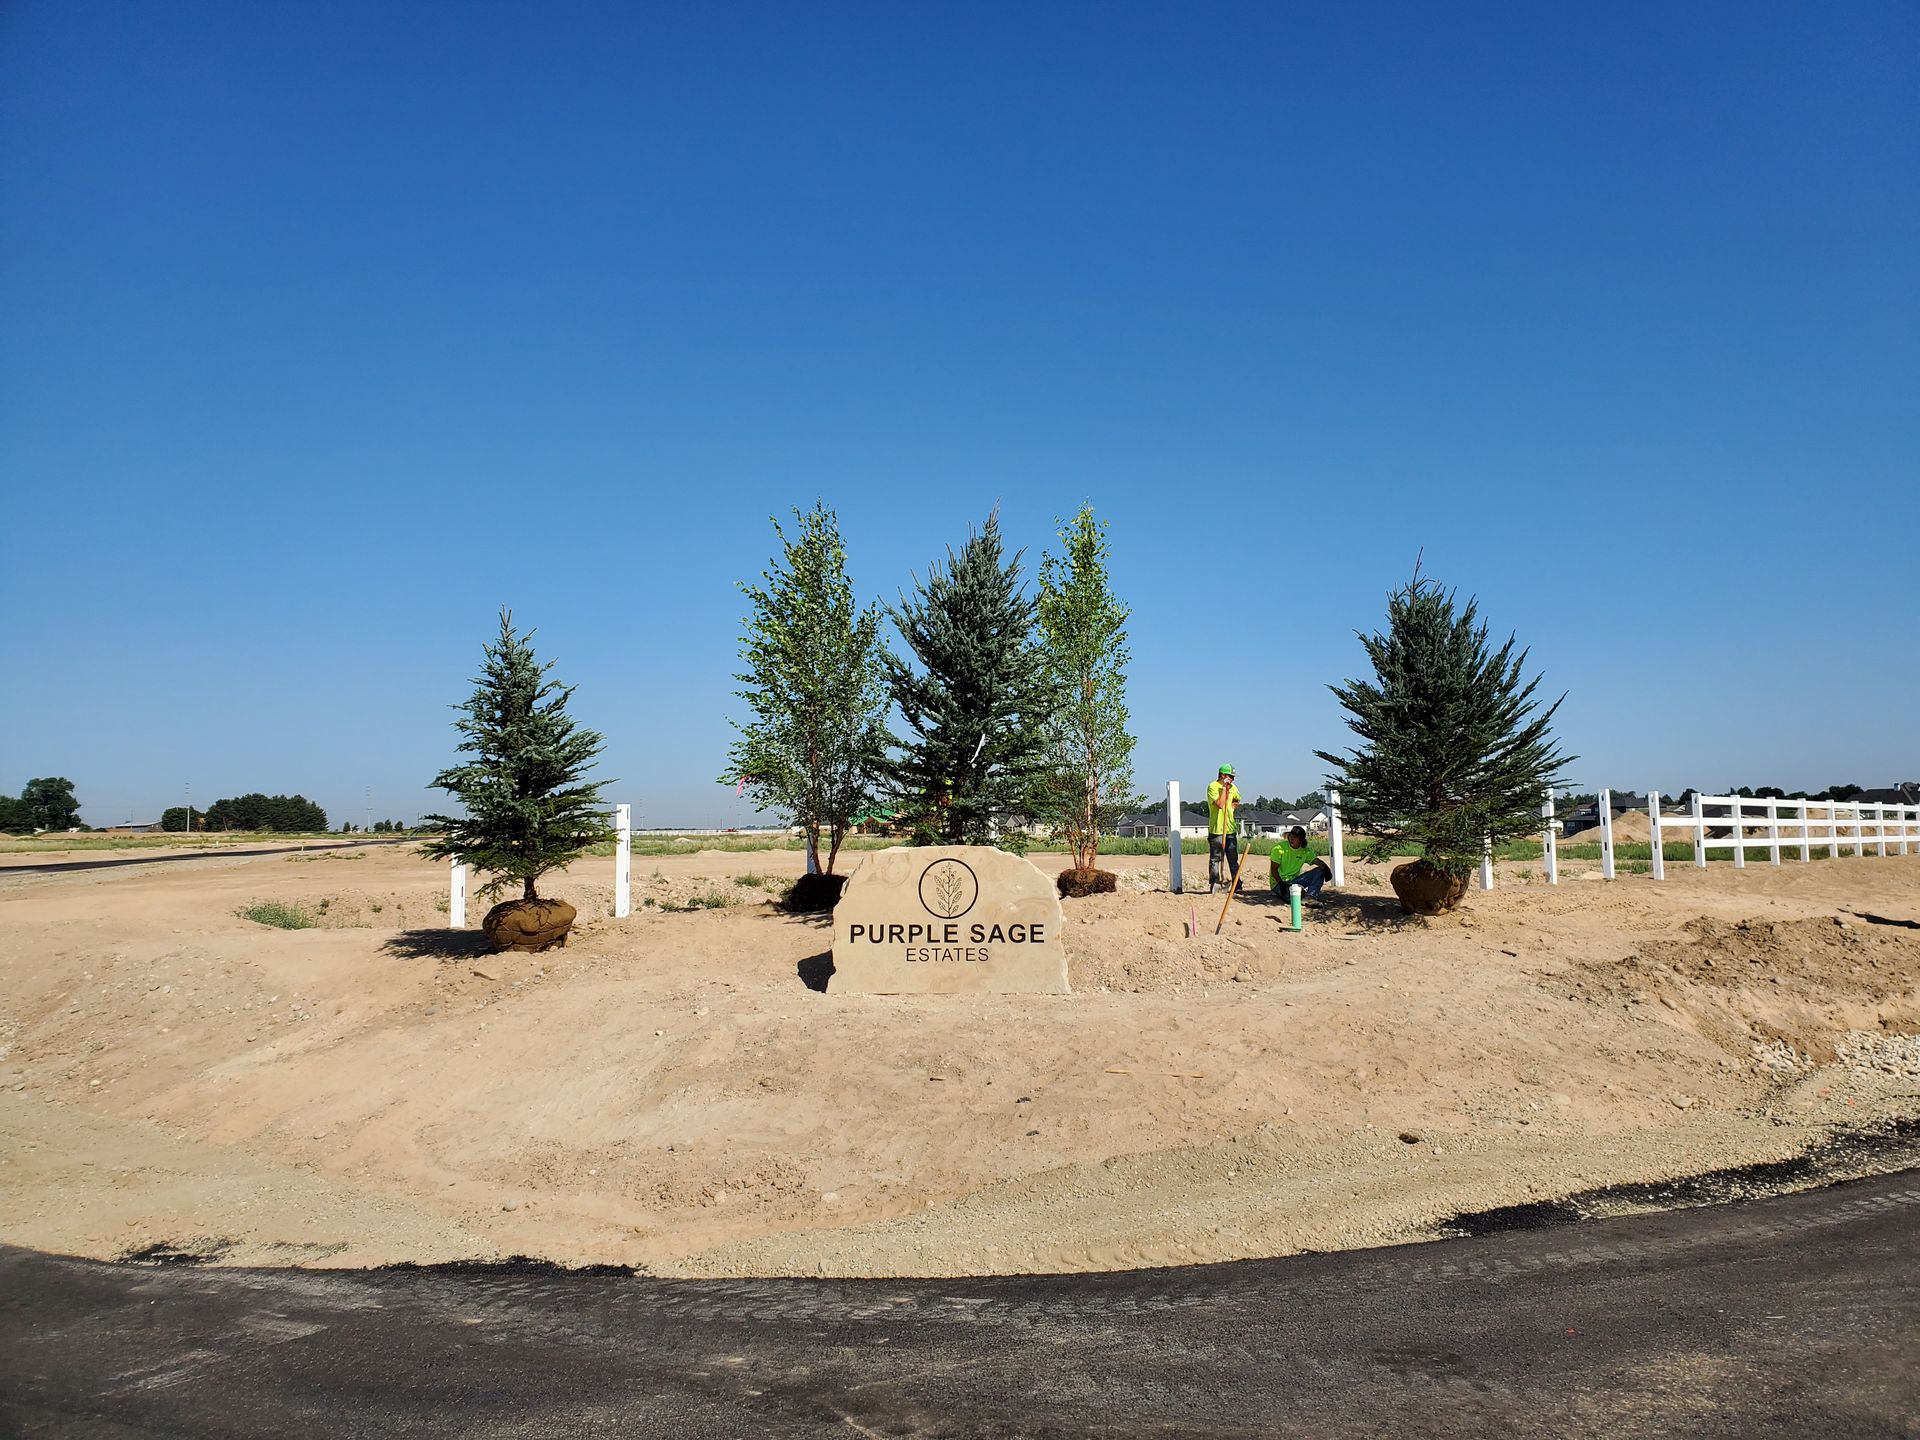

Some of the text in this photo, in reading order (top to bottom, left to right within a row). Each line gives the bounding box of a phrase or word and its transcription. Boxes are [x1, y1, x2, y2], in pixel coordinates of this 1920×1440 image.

[850, 923, 1045, 944] PURPLE SAGE
[906, 947, 989, 962] ESTATES
